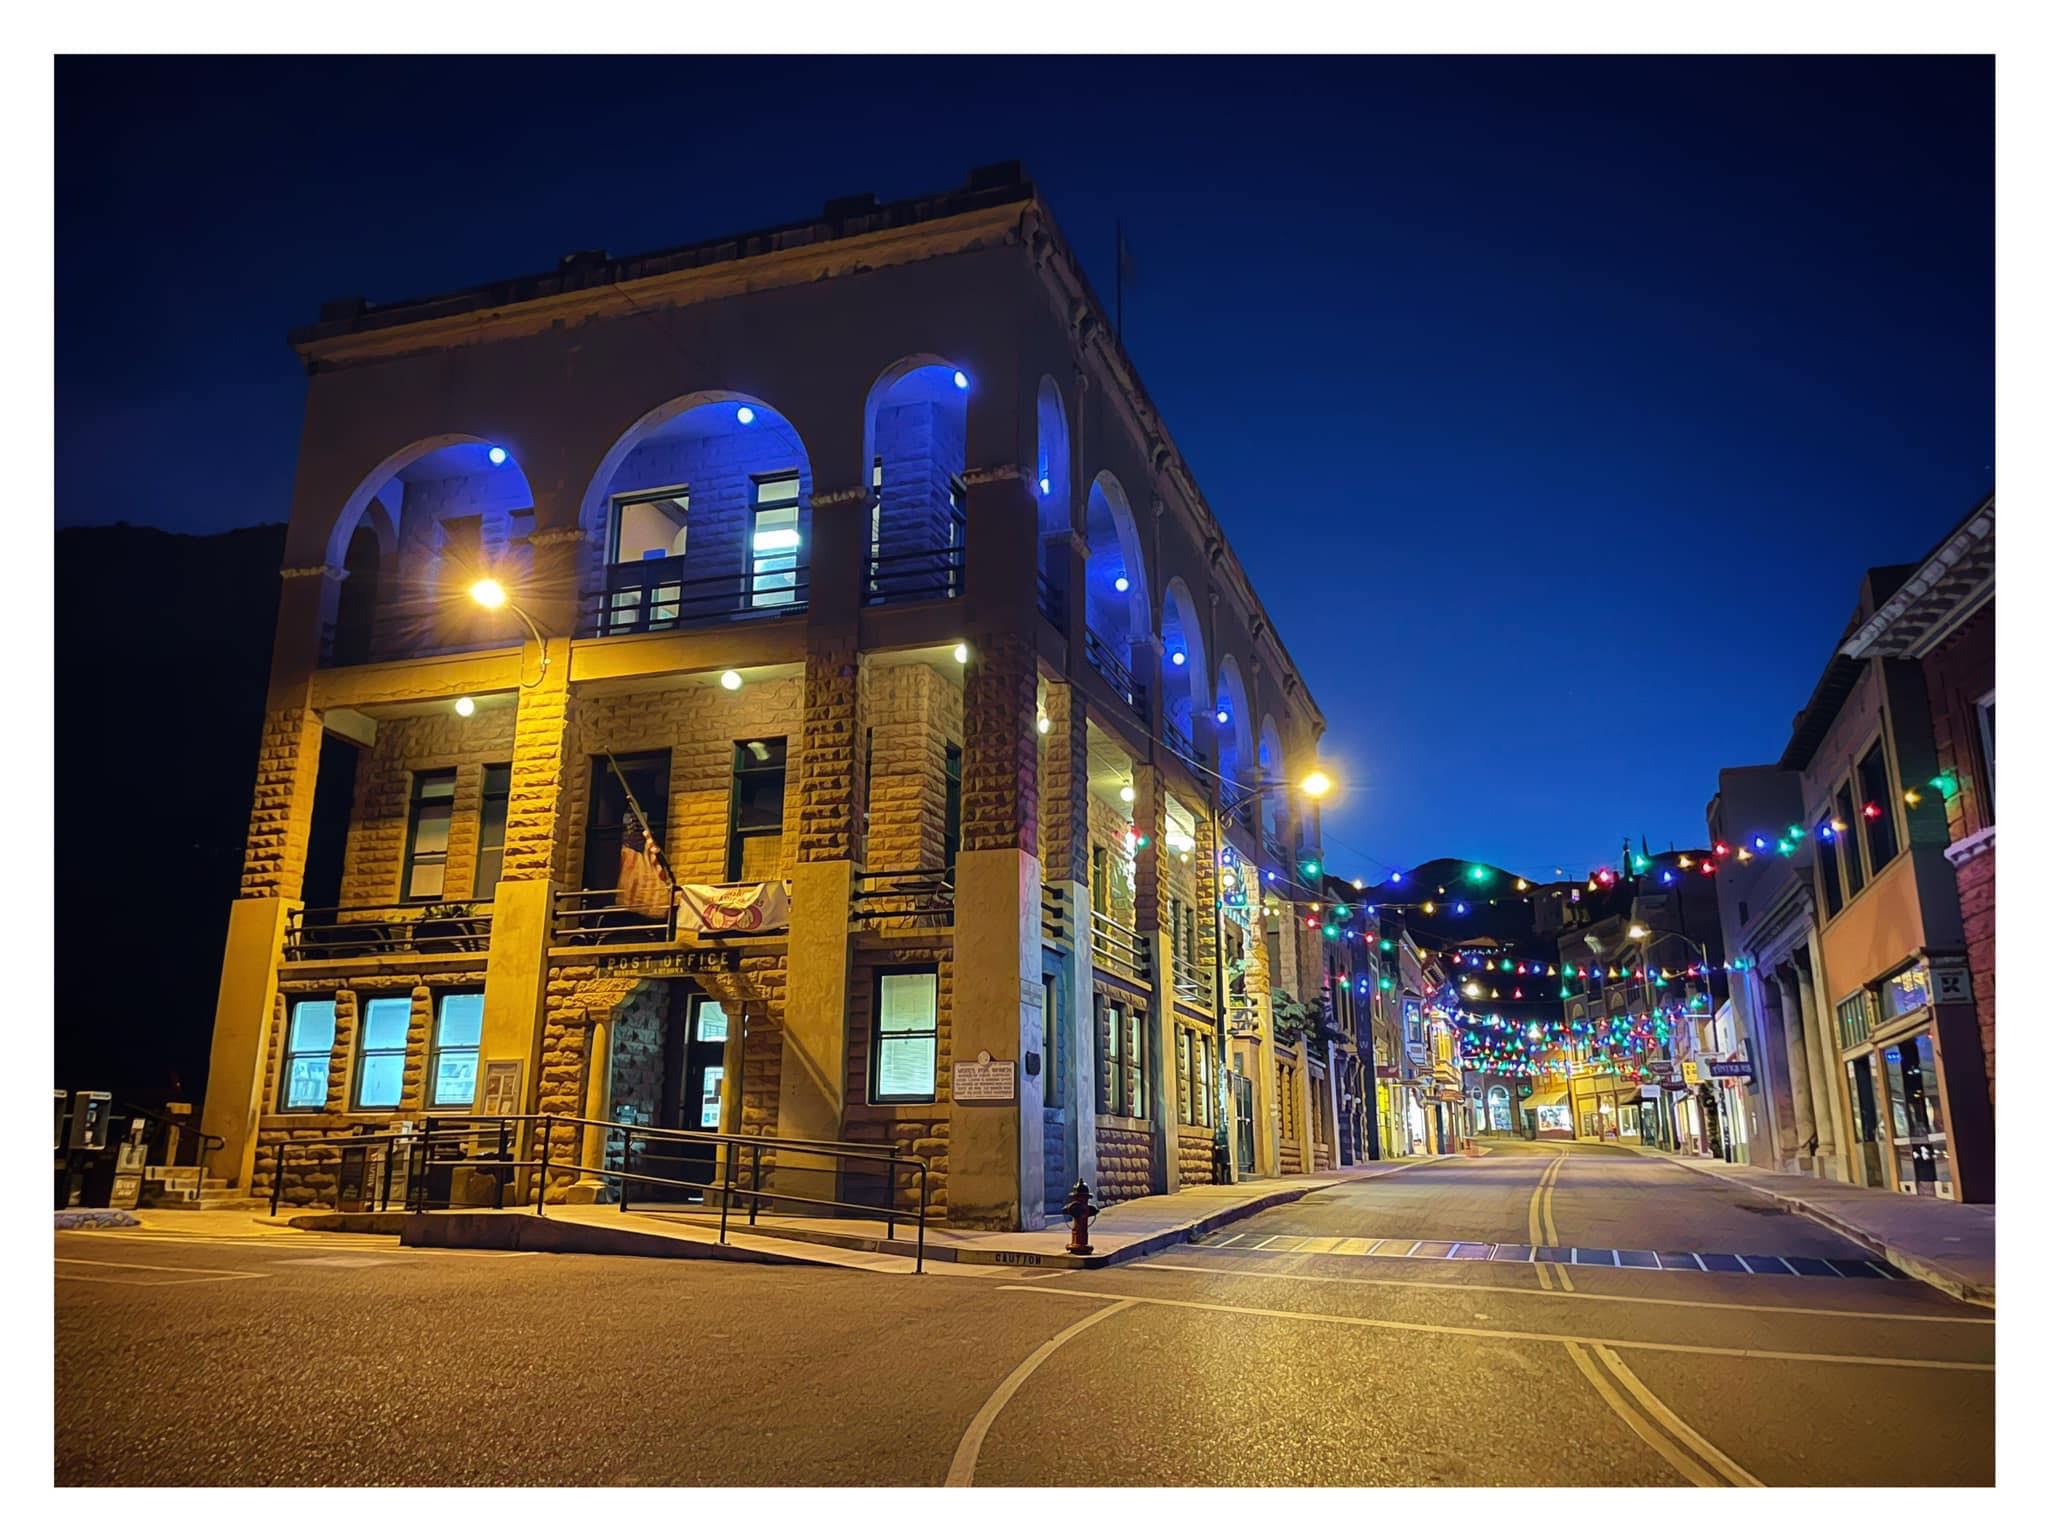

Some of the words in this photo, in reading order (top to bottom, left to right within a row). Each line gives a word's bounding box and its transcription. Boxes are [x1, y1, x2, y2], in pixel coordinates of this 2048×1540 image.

[608, 956, 652, 970] POST
[663, 953, 729, 968] OFFICE
[995, 1253, 1042, 1265] CAUTION
